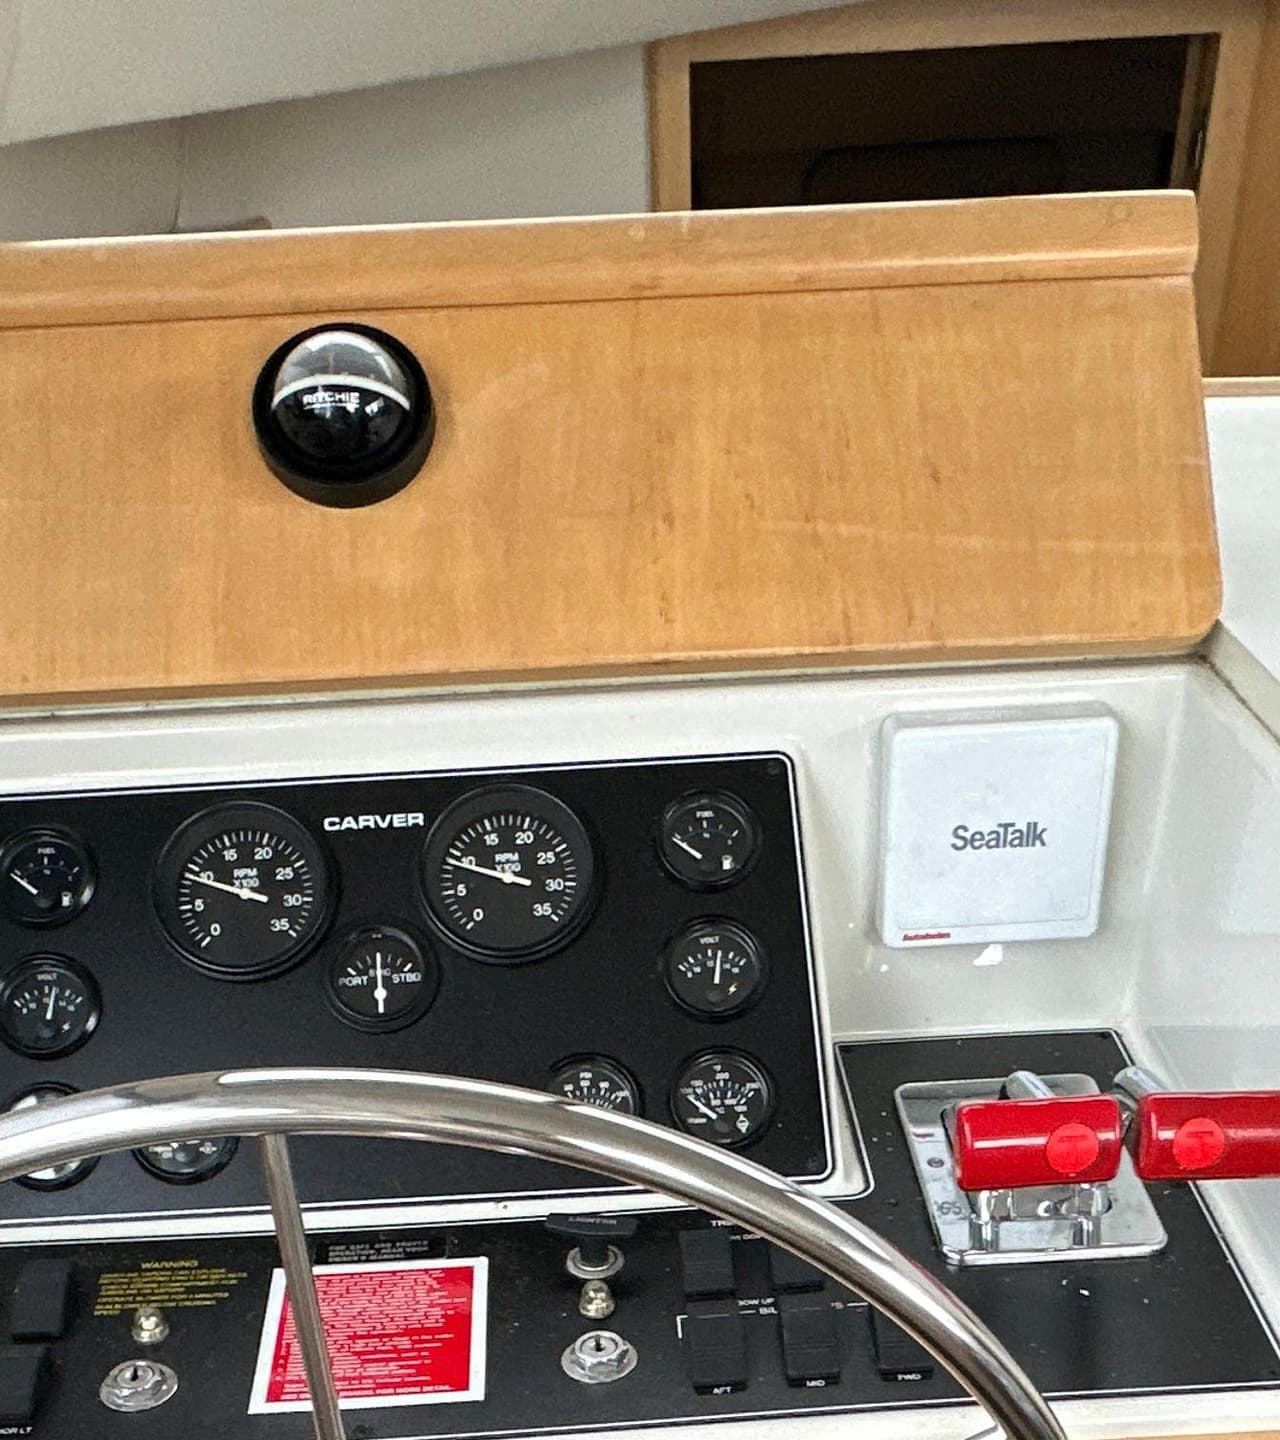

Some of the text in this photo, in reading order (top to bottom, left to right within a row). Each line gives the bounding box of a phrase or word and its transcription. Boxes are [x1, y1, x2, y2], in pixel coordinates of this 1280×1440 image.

[323, 812, 424, 831] CARVER
[483, 833, 499, 846] 15
[515, 831, 534, 845] 20
[950, 822, 1048, 851] SeaTalk
[222, 848, 238, 861] 15
[253, 847, 273, 860] 20
[495, 852, 520, 863] RPM
[536, 851, 556, 865] 25
[233, 868, 258, 878] RPM
[275, 867, 294, 880] 25
[456, 884, 467, 897] 5
[545, 879, 564, 892] 30
[194, 900, 205, 912] 5
[283, 894, 302, 907] 30
[473, 908, 484, 921] 0
[533, 903, 553, 917] 35
[210, 923, 221, 936] 0
[270, 918, 290, 932] 35
[338, 975, 368, 987] PORT
[391, 972, 421, 984] STBD
[712, 1385, 732, 1394] AFT
